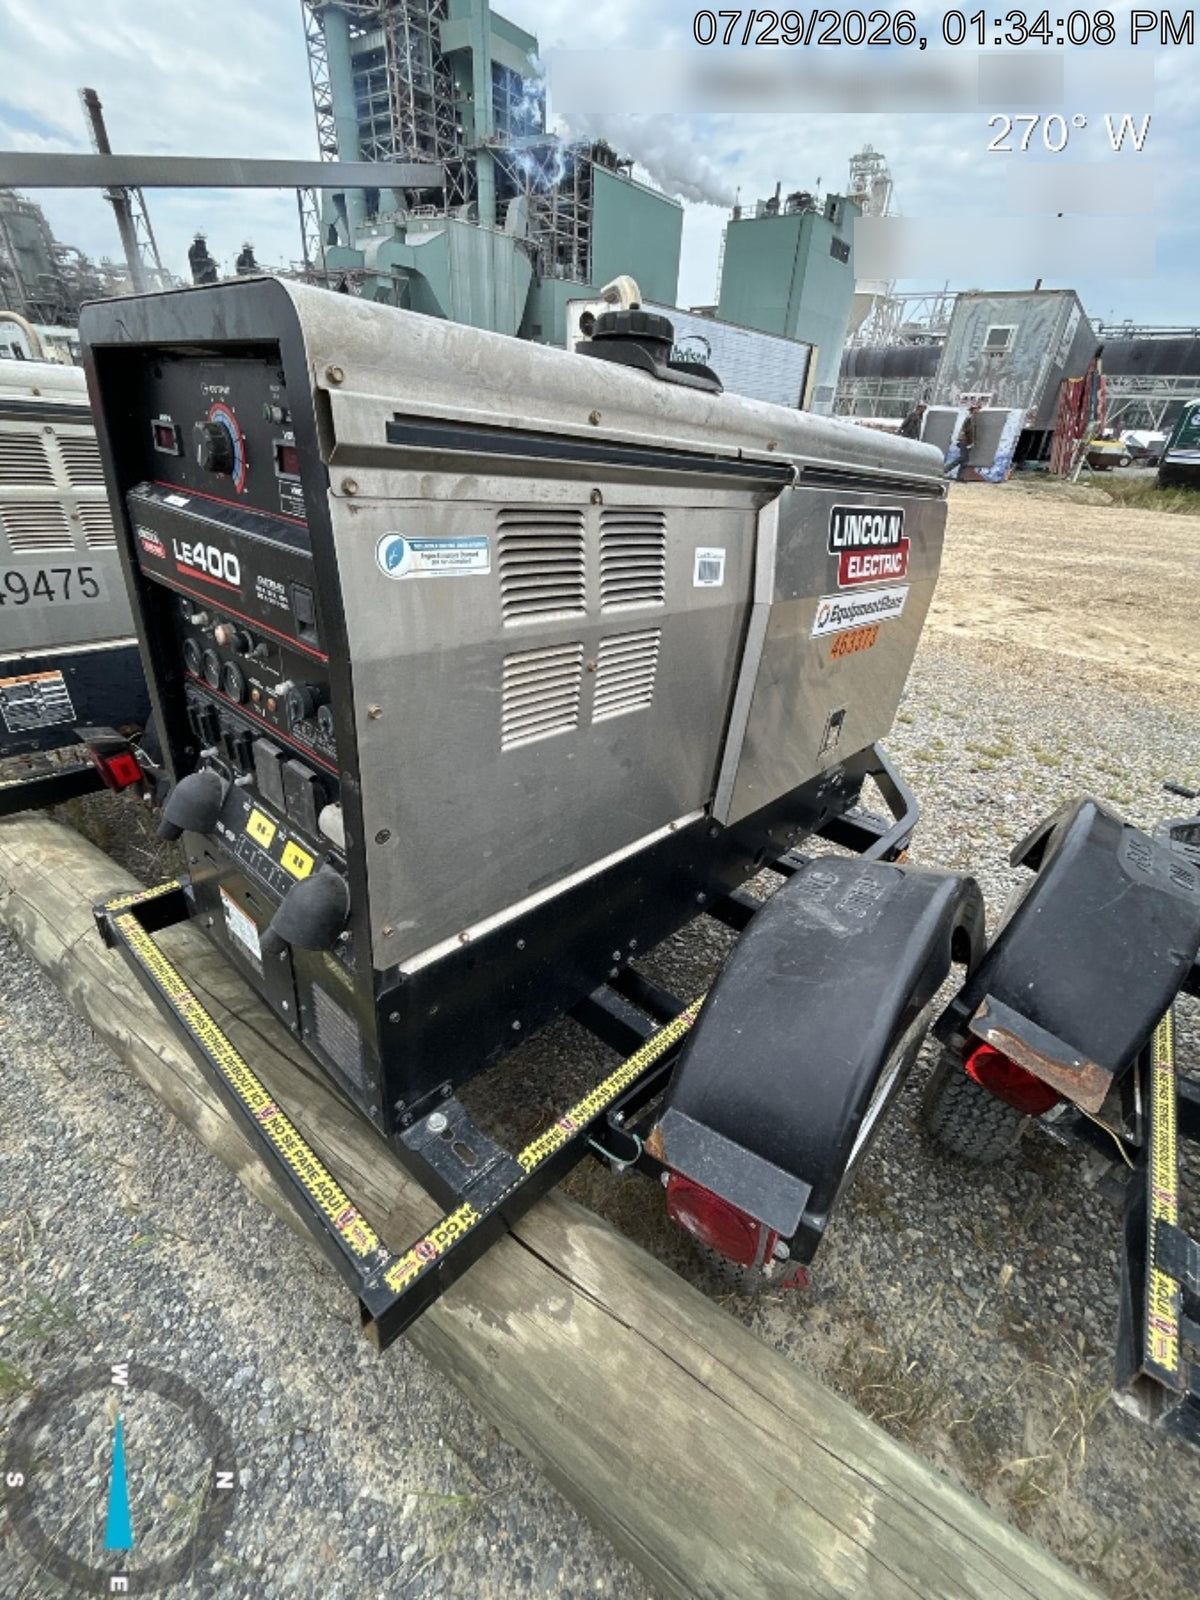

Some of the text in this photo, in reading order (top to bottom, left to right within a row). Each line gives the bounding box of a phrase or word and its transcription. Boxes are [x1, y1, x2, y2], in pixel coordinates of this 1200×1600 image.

[833, 513, 901, 547] LINCOLN
[172, 538, 240, 585] LE400
[847, 551, 902, 579] ELECTRIC
[192, 1012, 209, 1030] PAS
[203, 1028, 228, 1057] TENEZ
[223, 1055, 255, 1093] DEBOUT
[250, 1090, 266, 1107] ICI
[588, 1087, 611, 1106] PAS
[269, 1118, 286, 1135] NO
[282, 1133, 299, 1151] SE
[293, 1149, 321, 1181] PARE
[531, 1128, 562, 1157] HERE
[435, 1222, 459, 1243] DO
